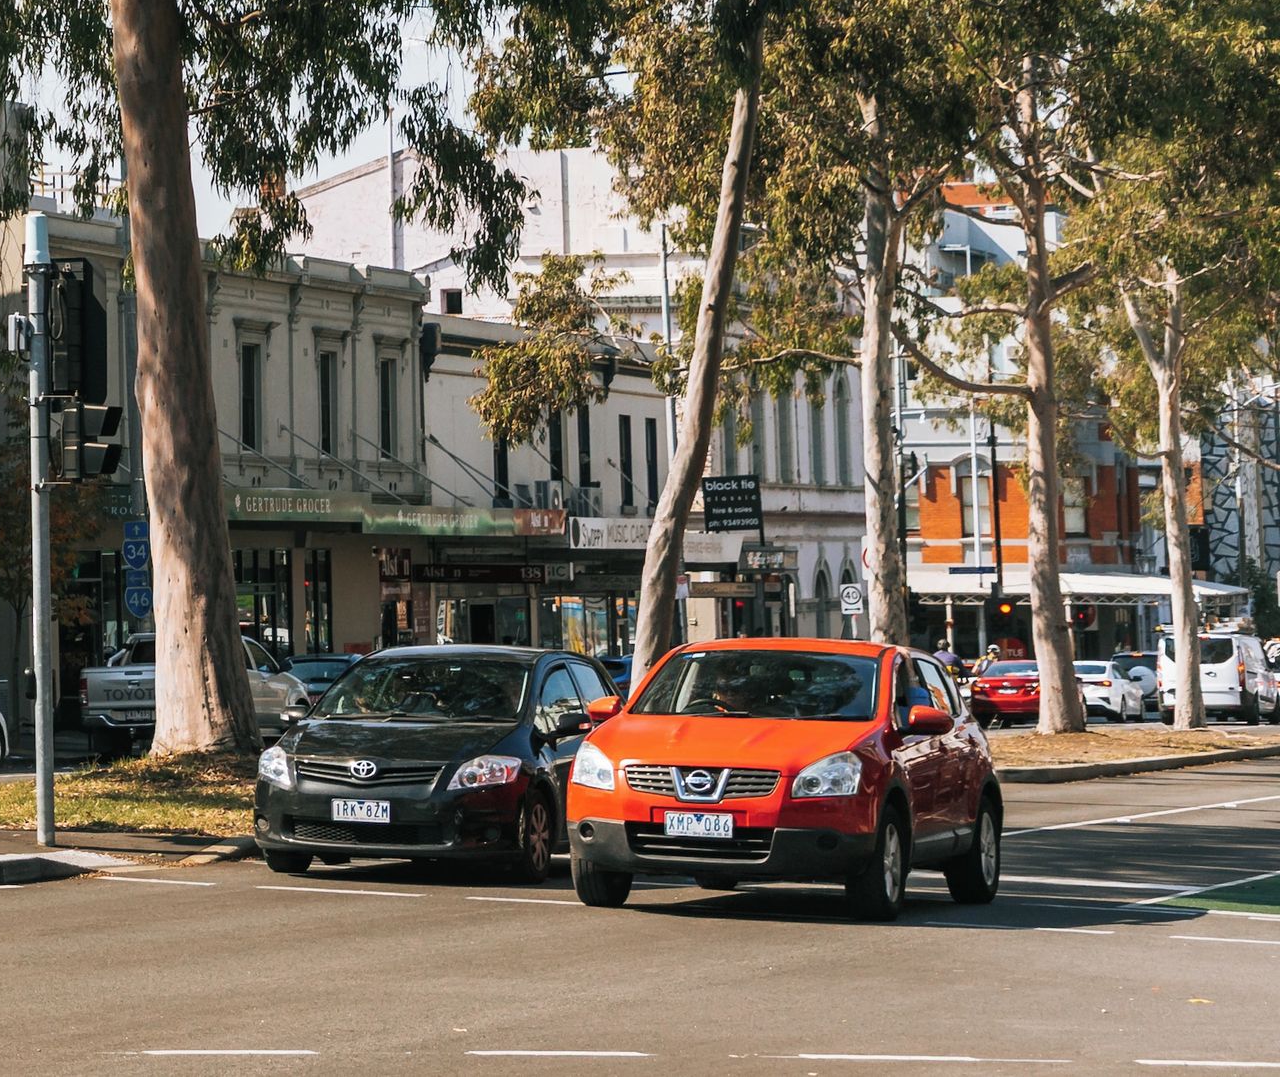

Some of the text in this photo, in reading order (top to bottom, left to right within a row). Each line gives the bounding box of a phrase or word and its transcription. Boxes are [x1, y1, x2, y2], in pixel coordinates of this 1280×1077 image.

[705, 479, 756, 491] black tie
[245, 497, 332, 513] GERTRUDE GROCER
[407, 513, 478, 528] GERTRUDE GROCER
[127, 544, 146, 559] 34
[520, 567, 541, 579] 138
[129, 593, 149, 606] 46
[844, 591, 858, 600] 40
[104, 688, 154, 701] TOYOT
